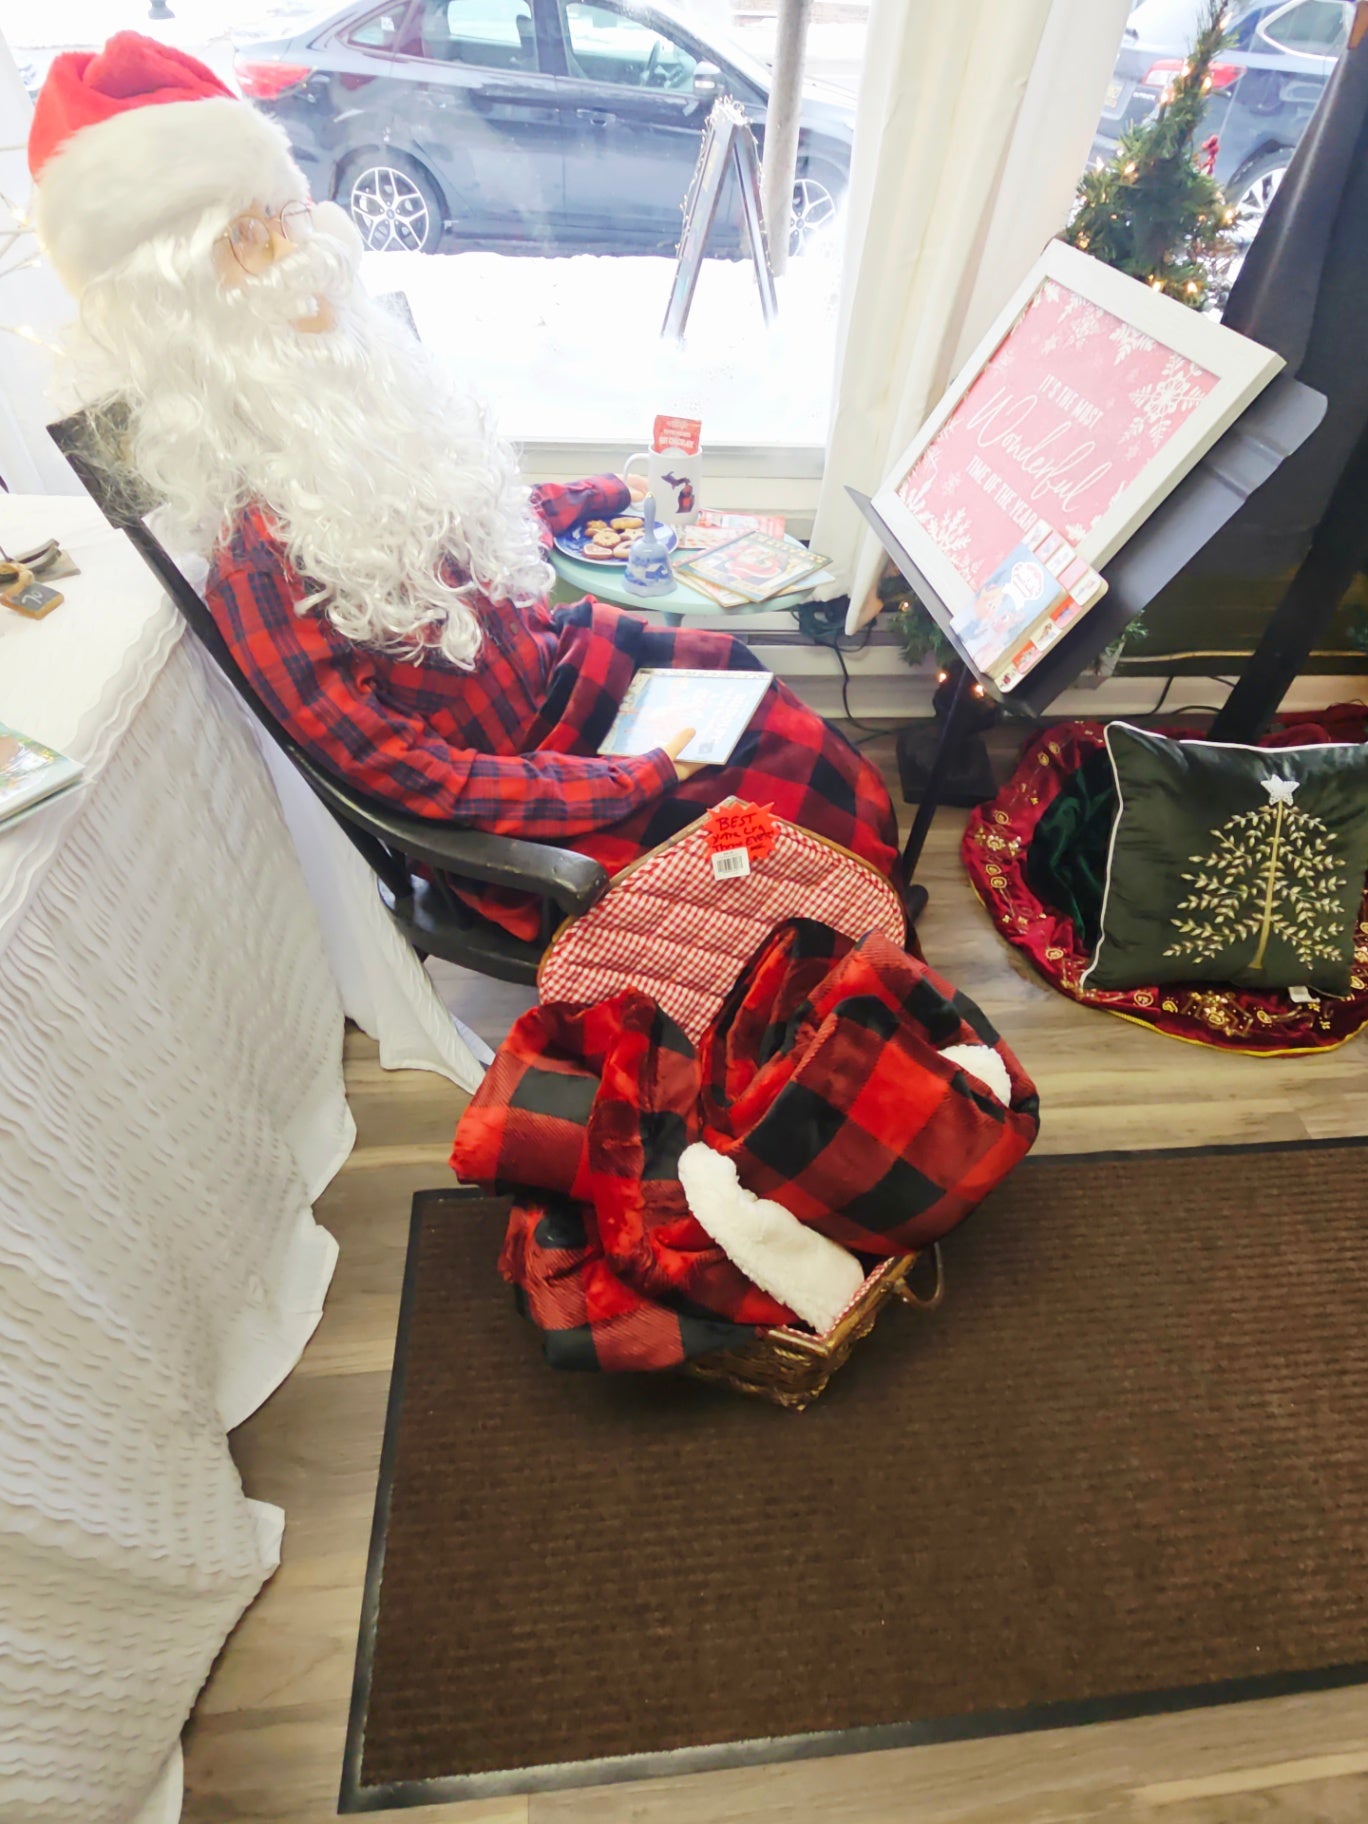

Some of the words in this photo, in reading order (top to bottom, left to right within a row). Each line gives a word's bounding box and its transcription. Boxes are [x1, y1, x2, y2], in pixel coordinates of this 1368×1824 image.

[1056, 386, 1079, 411] THE
[1071, 398, 1104, 430] MOST
[966, 386, 1112, 512] Wonderful
[966, 454, 991, 484] TIME
[983, 472, 1002, 494] OF
[993, 482, 1018, 512] THE
[1008, 497, 1038, 534] YEAR
[715, 812, 757, 831] BEST
